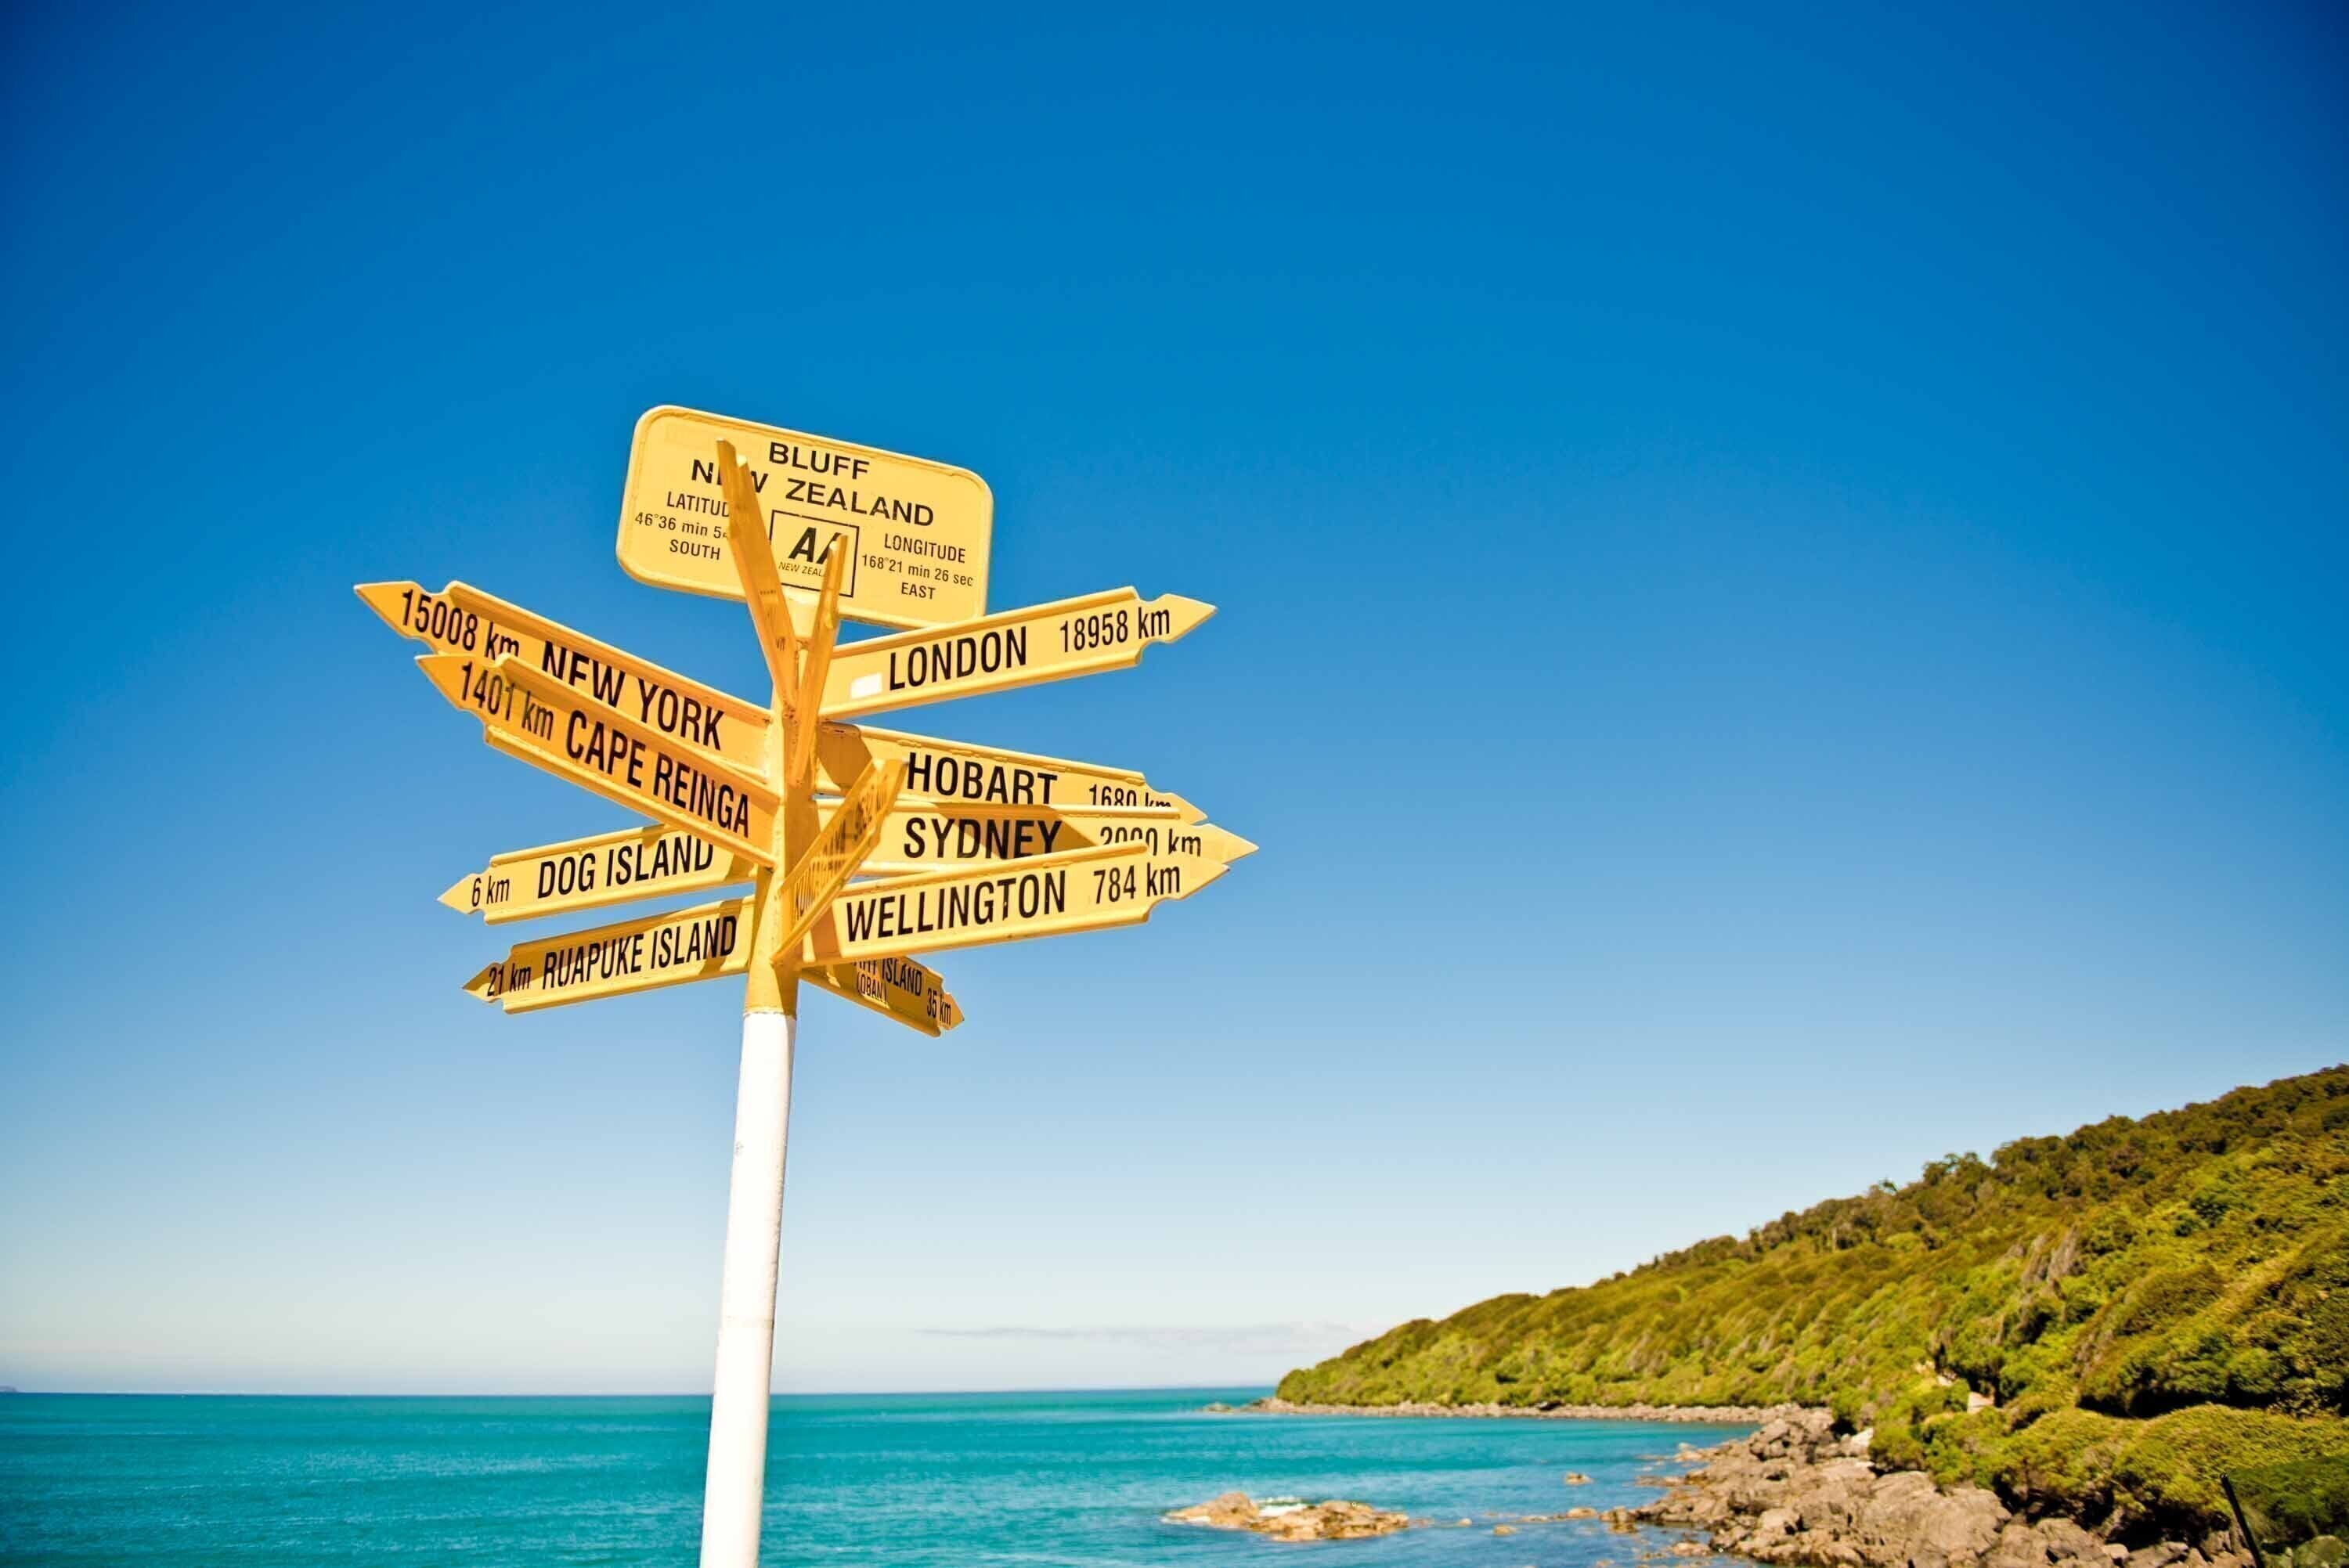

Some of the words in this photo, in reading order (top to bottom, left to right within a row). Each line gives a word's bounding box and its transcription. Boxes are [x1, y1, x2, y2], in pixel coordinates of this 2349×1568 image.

[769, 442, 869, 479] BLUFF
[666, 491, 730, 517] LATITUD
[691, 459, 768, 493] NW
[785, 478, 933, 526] ZEALAND
[669, 539, 720, 561] SOUTH
[681, 522, 708, 536] min
[885, 532, 965, 564] LONGITUDE
[778, 561, 800, 572] NEW
[801, 565, 824, 577] ZEAL
[901, 582, 936, 600] EAST
[908, 565, 930, 578] min
[935, 568, 949, 582] 26
[953, 574, 973, 586] sec
[402, 589, 478, 651] 15008
[484, 621, 520, 660] km
[542, 640, 626, 708] NEW
[638, 677, 724, 751] YORK
[889, 625, 1027, 690] LONDON
[1059, 606, 1129, 653] 18958
[1138, 607, 1171, 639] km
[461, 661, 515, 721] 1401
[521, 690, 554, 741] km
[566, 709, 647, 788] CAPE
[653, 752, 749, 838] REINGA
[907, 752, 1058, 805] HOBART
[1089, 784, 1137, 806] 1680
[1145, 792, 1171, 807] k
[904, 817, 1063, 860] SYDNEY
[1168, 827, 1201, 857] km
[471, 877, 482, 907] 6
[486, 875, 510, 905] km
[538, 852, 596, 899] DOG
[605, 834, 714, 887] ISLAND
[846, 870, 1066, 942] WELLINGTON
[1093, 864, 1136, 905] 784
[1146, 861, 1181, 899] km
[487, 968, 504, 997] 21
[508, 962, 532, 992] km
[543, 932, 644, 990] RUAPUKE
[651, 915, 737, 969] ISLAND
[882, 957, 922, 997] ISLAND
[926, 987, 937, 1018] 35
[939, 993, 951, 1025] km
